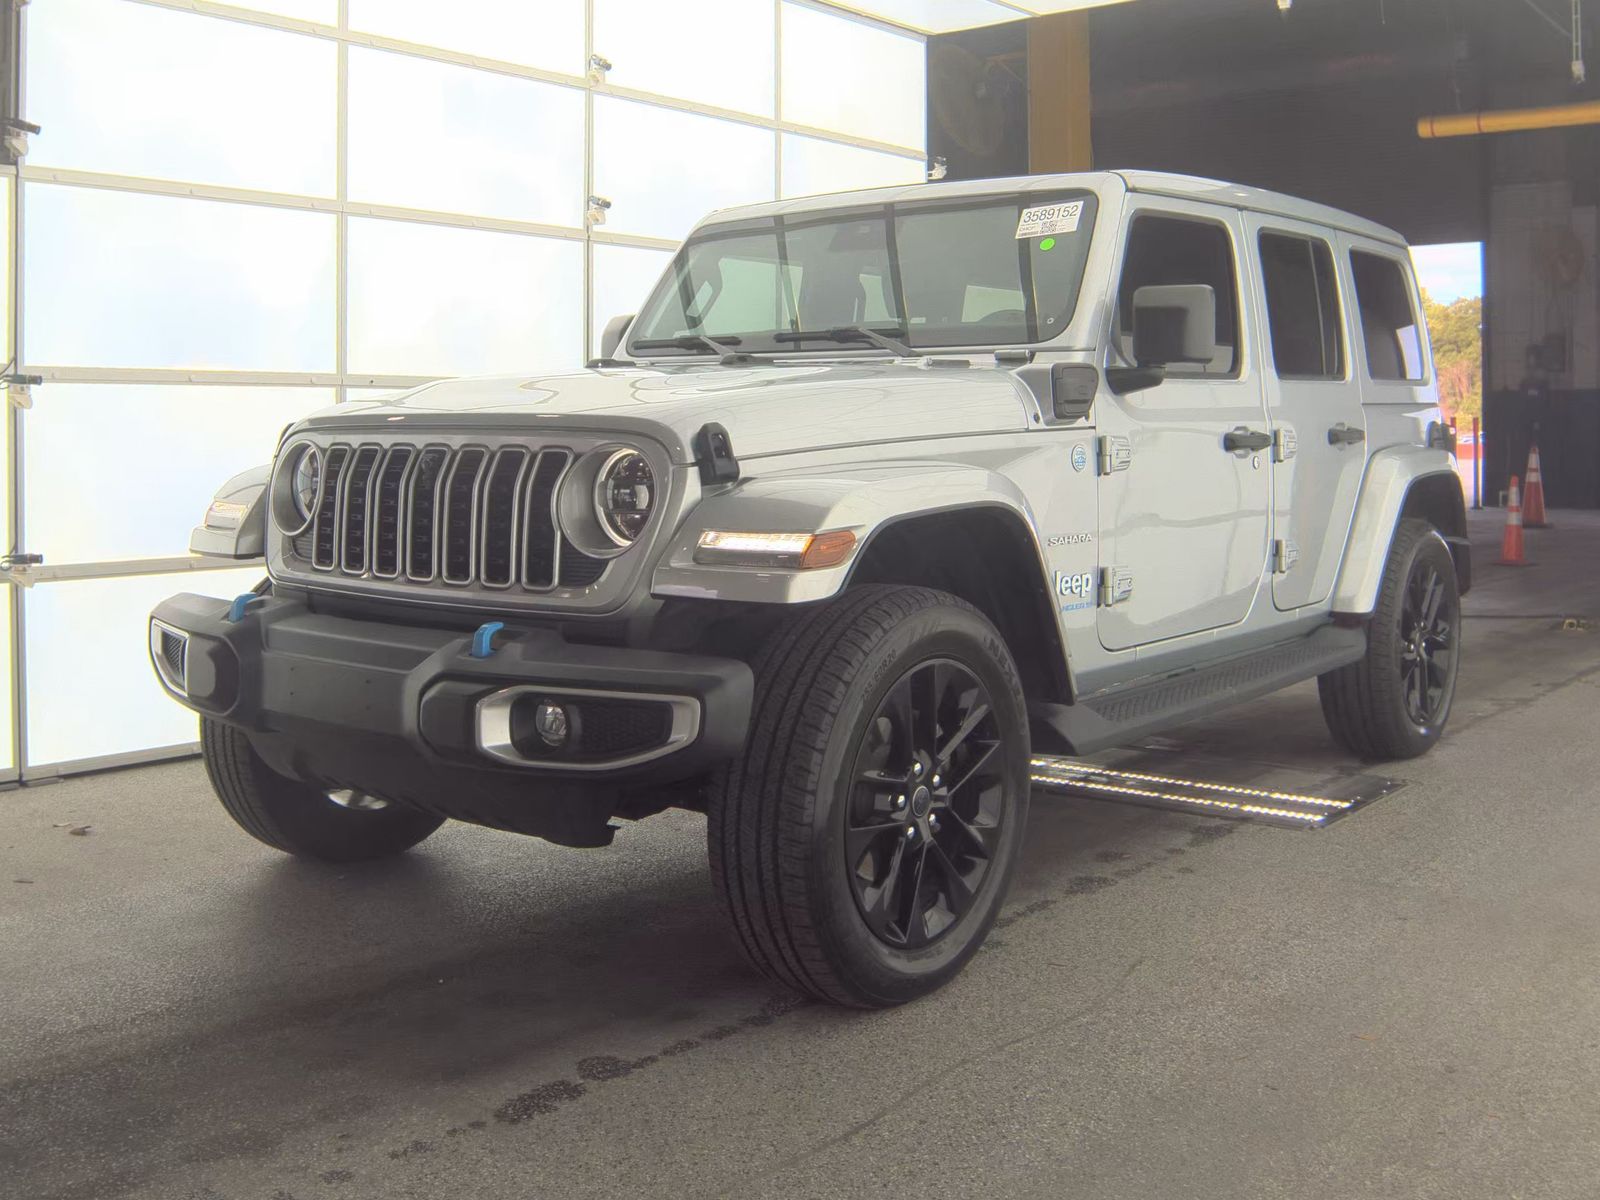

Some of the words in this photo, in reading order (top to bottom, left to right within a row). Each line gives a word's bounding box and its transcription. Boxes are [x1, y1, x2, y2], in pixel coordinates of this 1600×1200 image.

[1023, 205, 1079, 223] 3589152
[1048, 533, 1092, 546] SAHARA
[1054, 570, 1092, 598] Jeep
